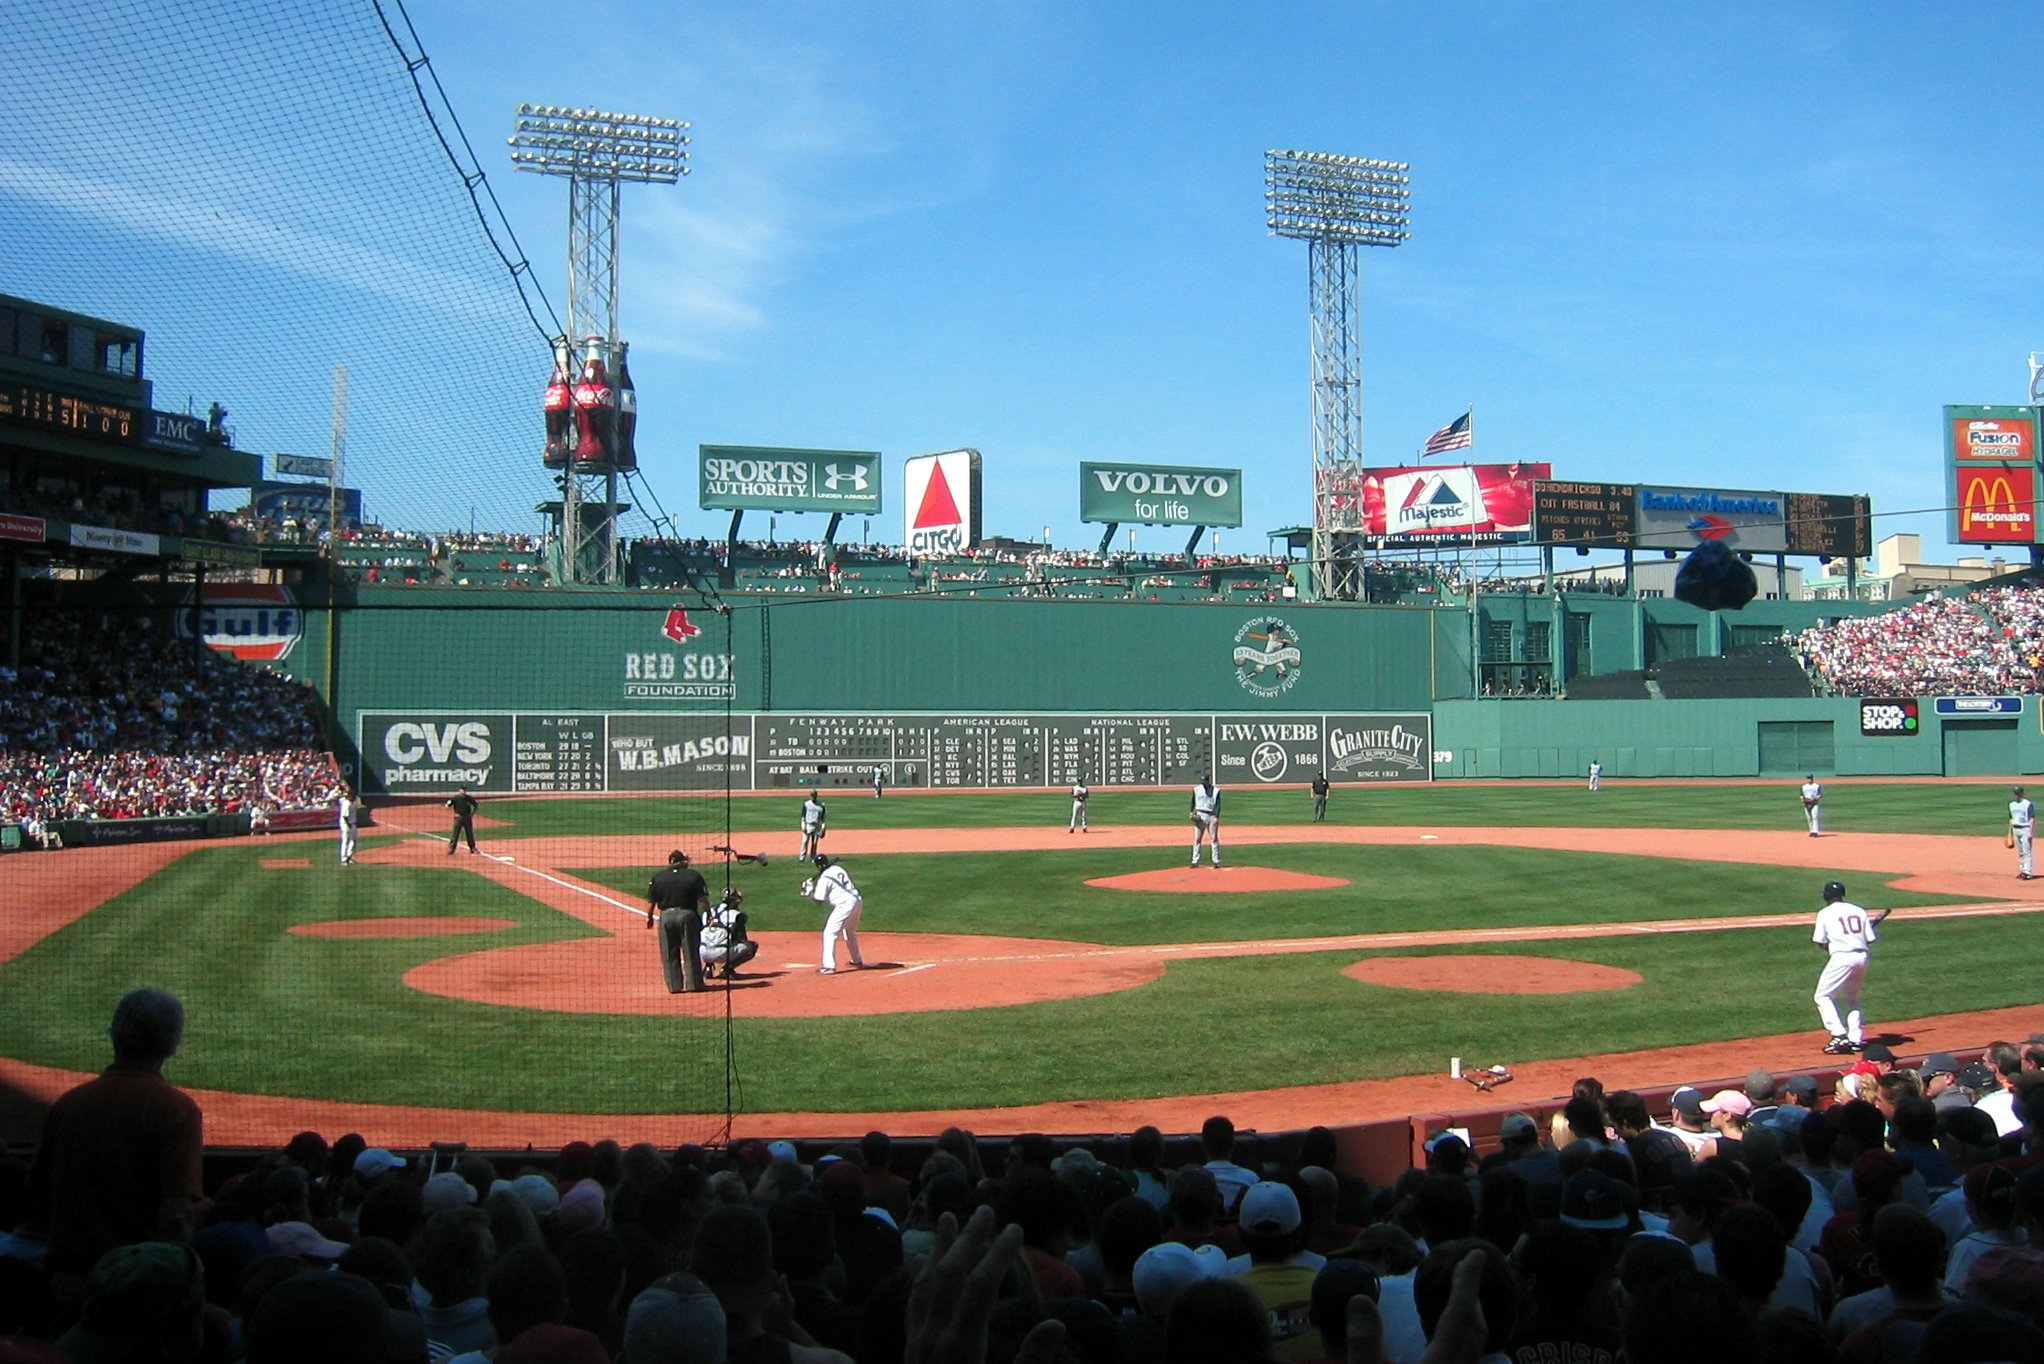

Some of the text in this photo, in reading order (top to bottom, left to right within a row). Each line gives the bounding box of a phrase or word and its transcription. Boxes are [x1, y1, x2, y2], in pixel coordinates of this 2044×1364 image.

[1970, 431, 2020, 444] Fusion
[704, 458, 808, 484] SPORTS
[705, 482, 808, 498] AUTHORITY
[1093, 470, 1229, 498] VOLVO
[1135, 499, 1189, 519] for life
[1641, 490, 1684, 511] Bank
[1399, 505, 1465, 523] Majestic
[1970, 513, 2031, 522] McDonald's
[913, 527, 962, 551] CITGO
[625, 653, 736, 681] RED SOX
[628, 686, 733, 697] FOUNDATION
[542, 718, 579, 727] AL EAST
[943, 718, 1029, 726] AMERICAN LEAGUE
[558, 731, 569, 740] W
[1220, 724, 1318, 741] F.W. WEBB
[385, 722, 491, 765] CVS
[611, 738, 654, 749] WHO BUT
[857, 764, 874, 773] OUT
[1220, 754, 1318, 766] Since 1866
[385, 765, 492, 787] pharmacy
[1838, 914, 1862, 935] 10
